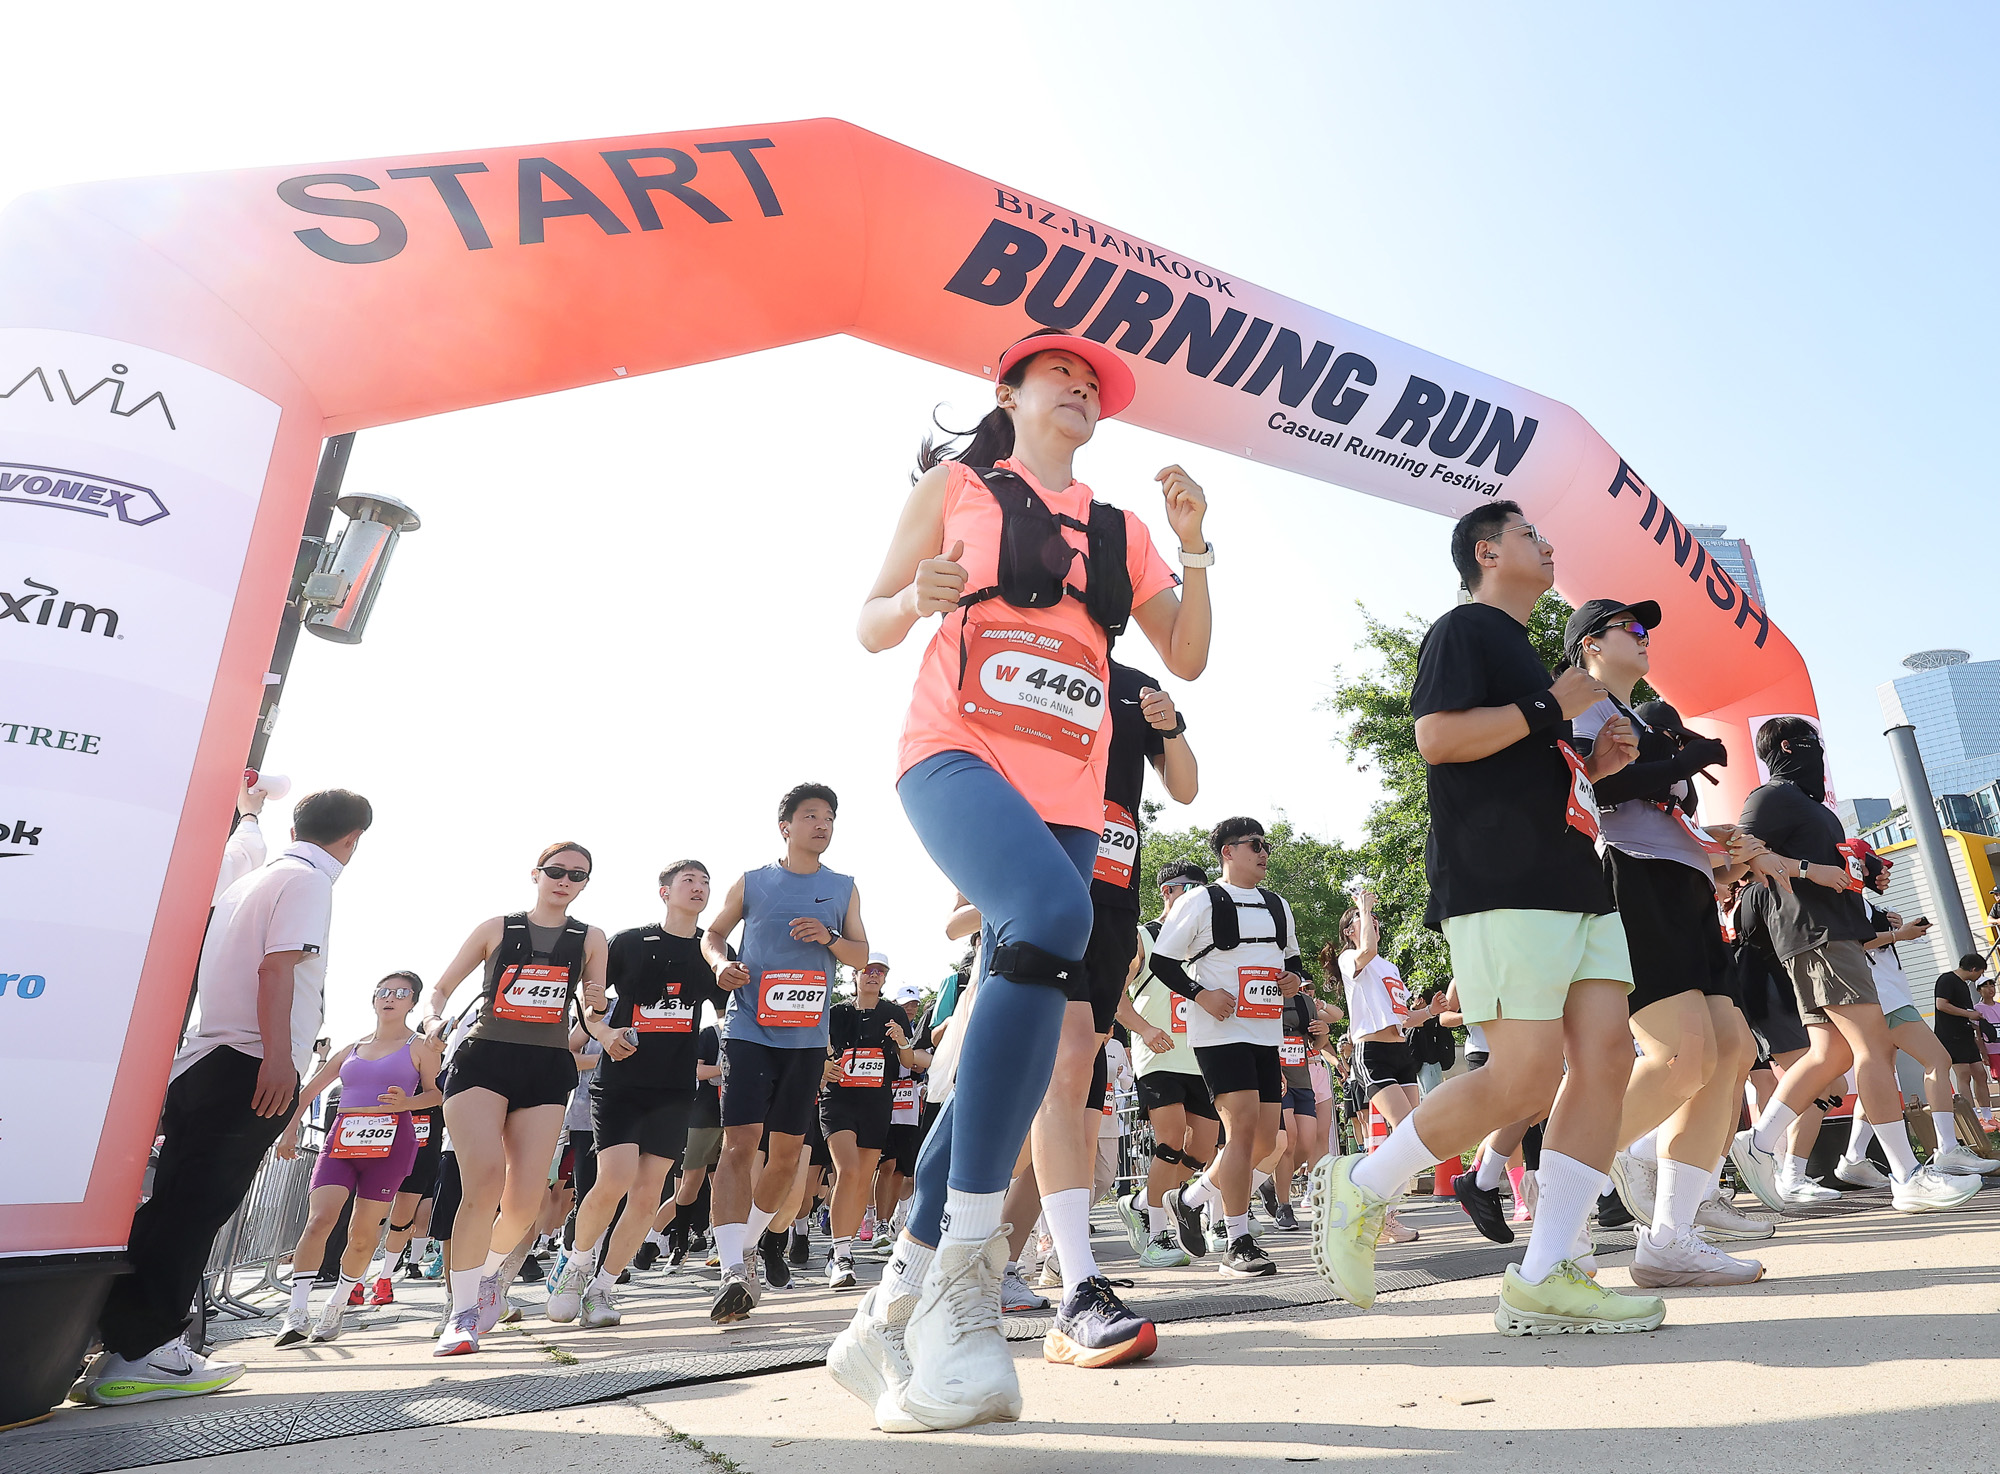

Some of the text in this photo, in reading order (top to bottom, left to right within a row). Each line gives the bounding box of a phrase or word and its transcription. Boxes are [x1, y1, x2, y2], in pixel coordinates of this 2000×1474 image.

[277, 138, 784, 264] START
[943, 218, 1539, 477] BURNING RUN
[1267, 412, 1504, 497] Casual Running Festival
[1608, 457, 1768, 649] FINISH
[981, 629, 1064, 650] BURNING RUN
[996, 664, 1020, 682] W
[1026, 668, 1101, 708] 4460
[978, 706, 1003, 717] Bag Drop
[1018, 692, 1074, 716] SONG ANNA
[0, 722, 101, 755] TREE
[1100, 827, 1135, 851] 620
[512, 986, 566, 998] W 4512
[773, 990, 824, 1002] M 2087
[1249, 987, 1258, 995] M
[858, 1062, 883, 1070] 4535
[357, 1129, 394, 1138] 4305
[414, 1126, 429, 1134] 29
